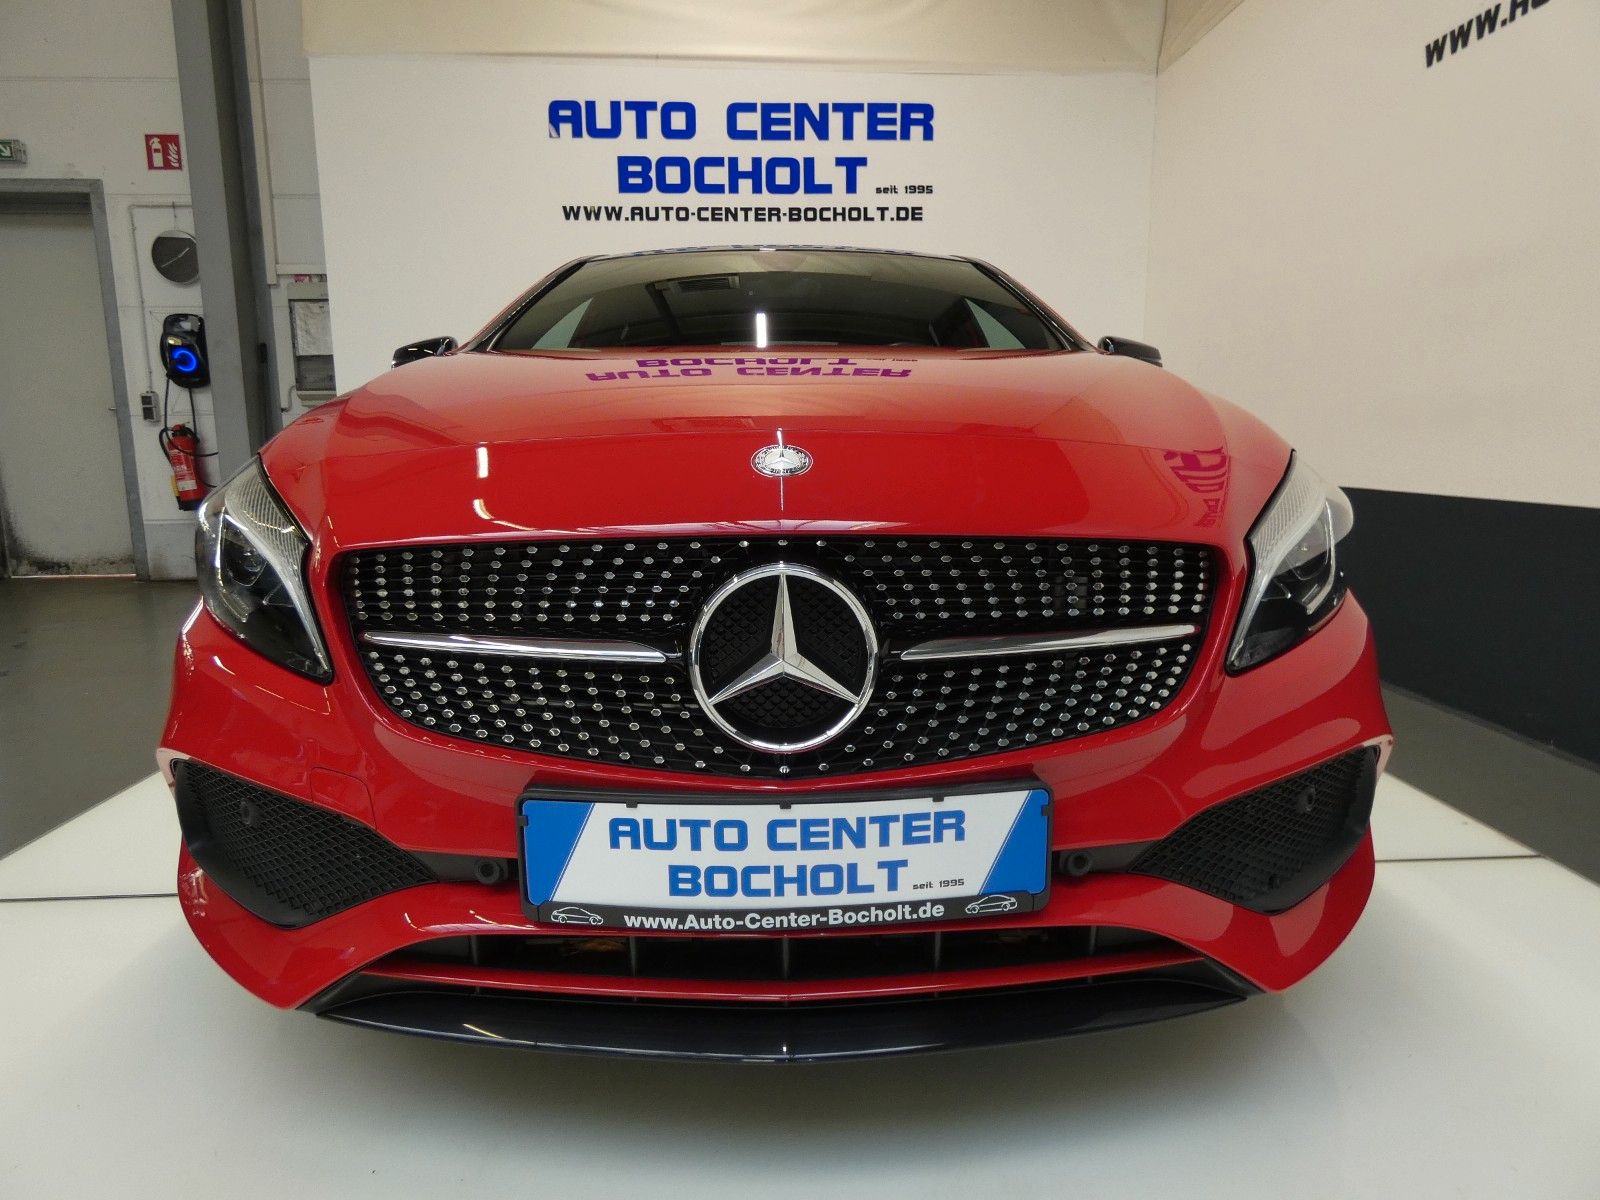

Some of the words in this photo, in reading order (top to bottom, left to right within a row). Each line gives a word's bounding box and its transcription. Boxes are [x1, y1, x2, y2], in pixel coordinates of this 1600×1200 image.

[548, 100, 697, 140] AUTO
[726, 102, 934, 141] CENTER
[617, 155, 868, 194] BOCHOLT
[875, 185, 898, 194] seit
[904, 185, 934, 194] 1995
[562, 206, 923, 222] WWW.AUTO-CENTER-BOCHOLT.DE
[609, 818, 749, 851] AUTO
[766, 810, 966, 852] CENTER
[669, 859, 909, 897] BOCHOLT
[912, 881, 934, 890] seit
[939, 878, 965, 888] 1995
[623, 902, 945, 931] www.Auto-Center-Bocholt.de
